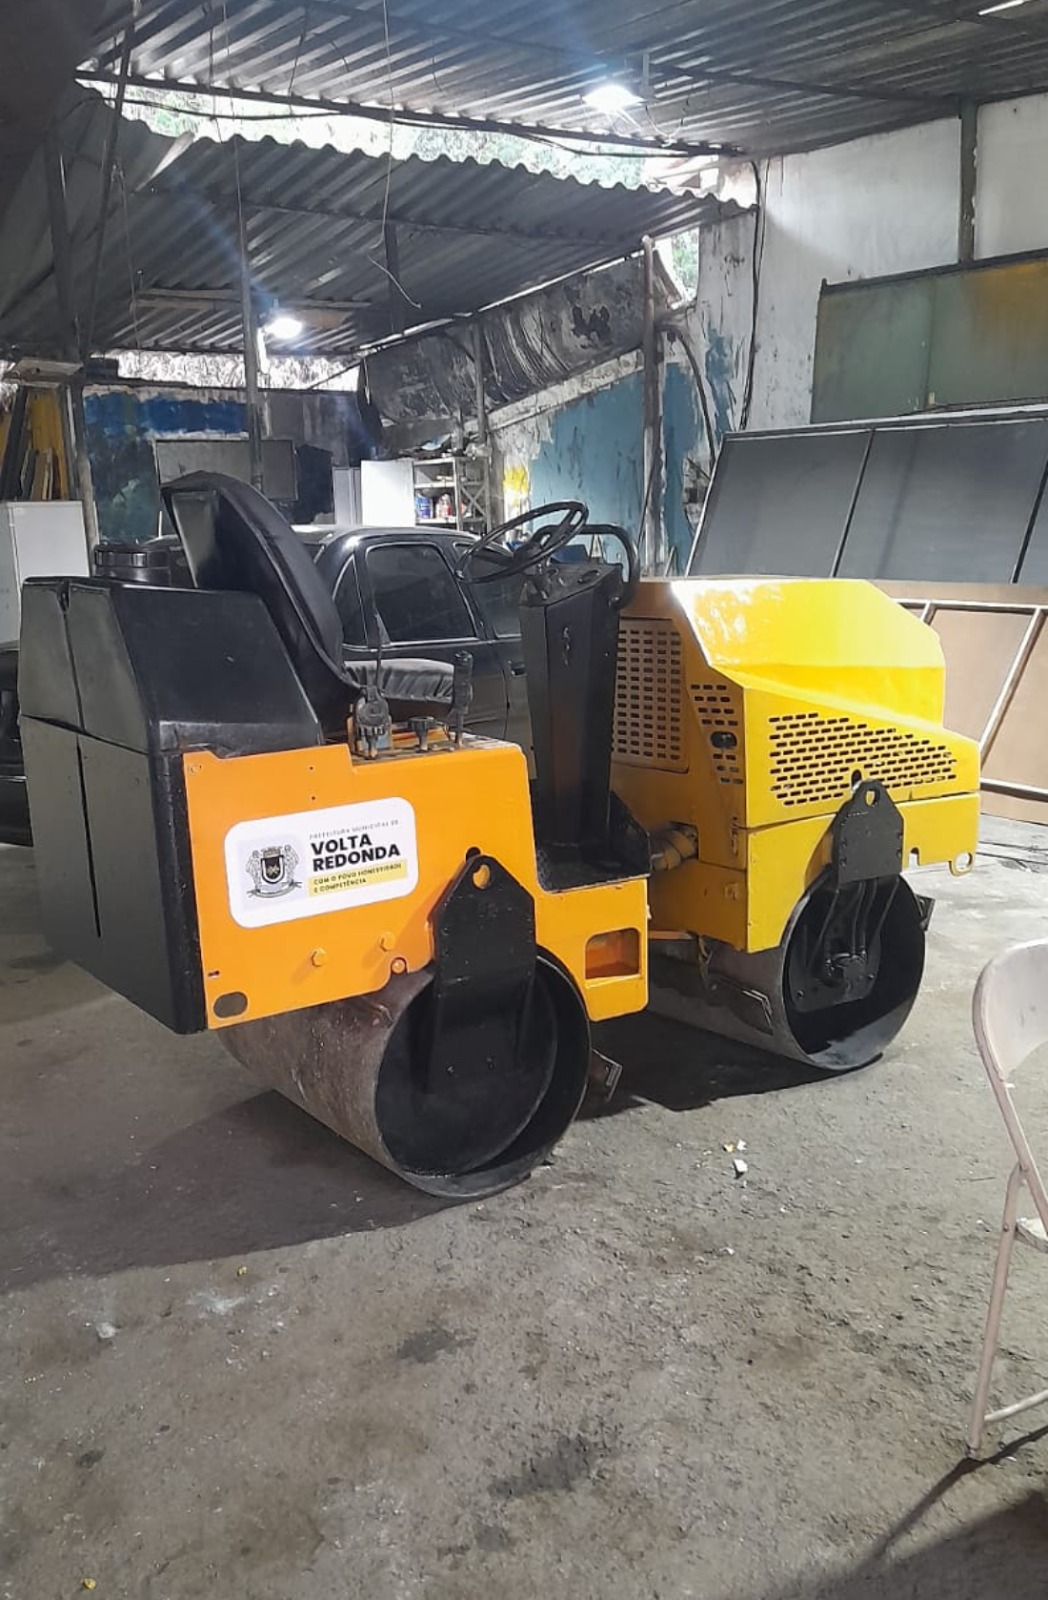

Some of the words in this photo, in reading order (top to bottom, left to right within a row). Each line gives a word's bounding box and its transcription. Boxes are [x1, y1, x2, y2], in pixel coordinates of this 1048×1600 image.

[311, 833, 372, 855] VOLTA
[312, 844, 400, 872] REDONDA
[314, 877, 330, 885] COM
[319, 878, 367, 892] COMPETÊNCIA
